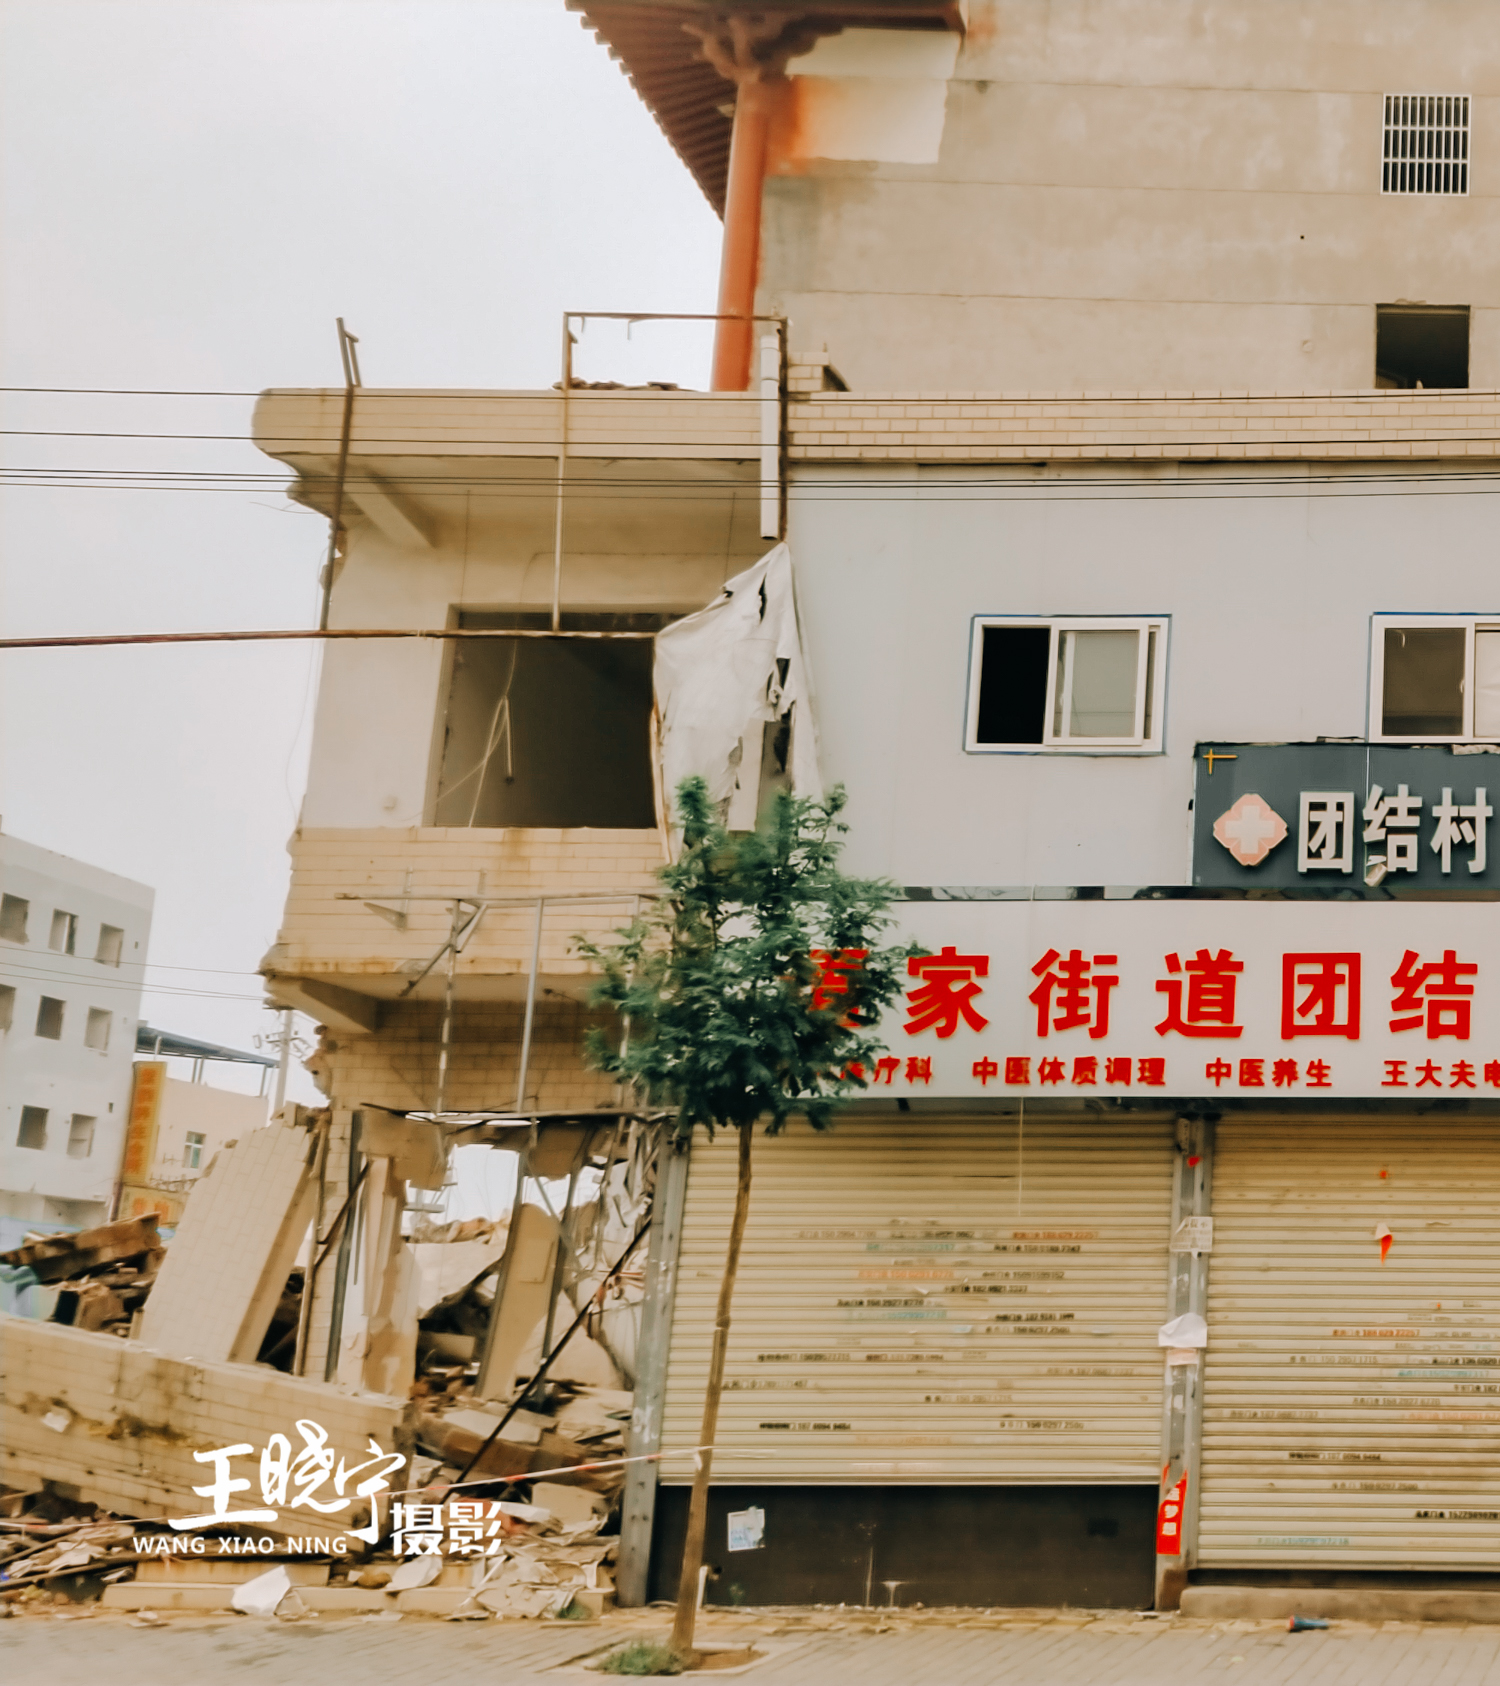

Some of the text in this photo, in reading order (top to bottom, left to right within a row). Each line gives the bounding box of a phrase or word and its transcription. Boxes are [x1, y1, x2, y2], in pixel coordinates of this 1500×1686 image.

[972, 1056, 1166, 1086] 中医体质调理
[1205, 1058, 1332, 1088] 中医养生
